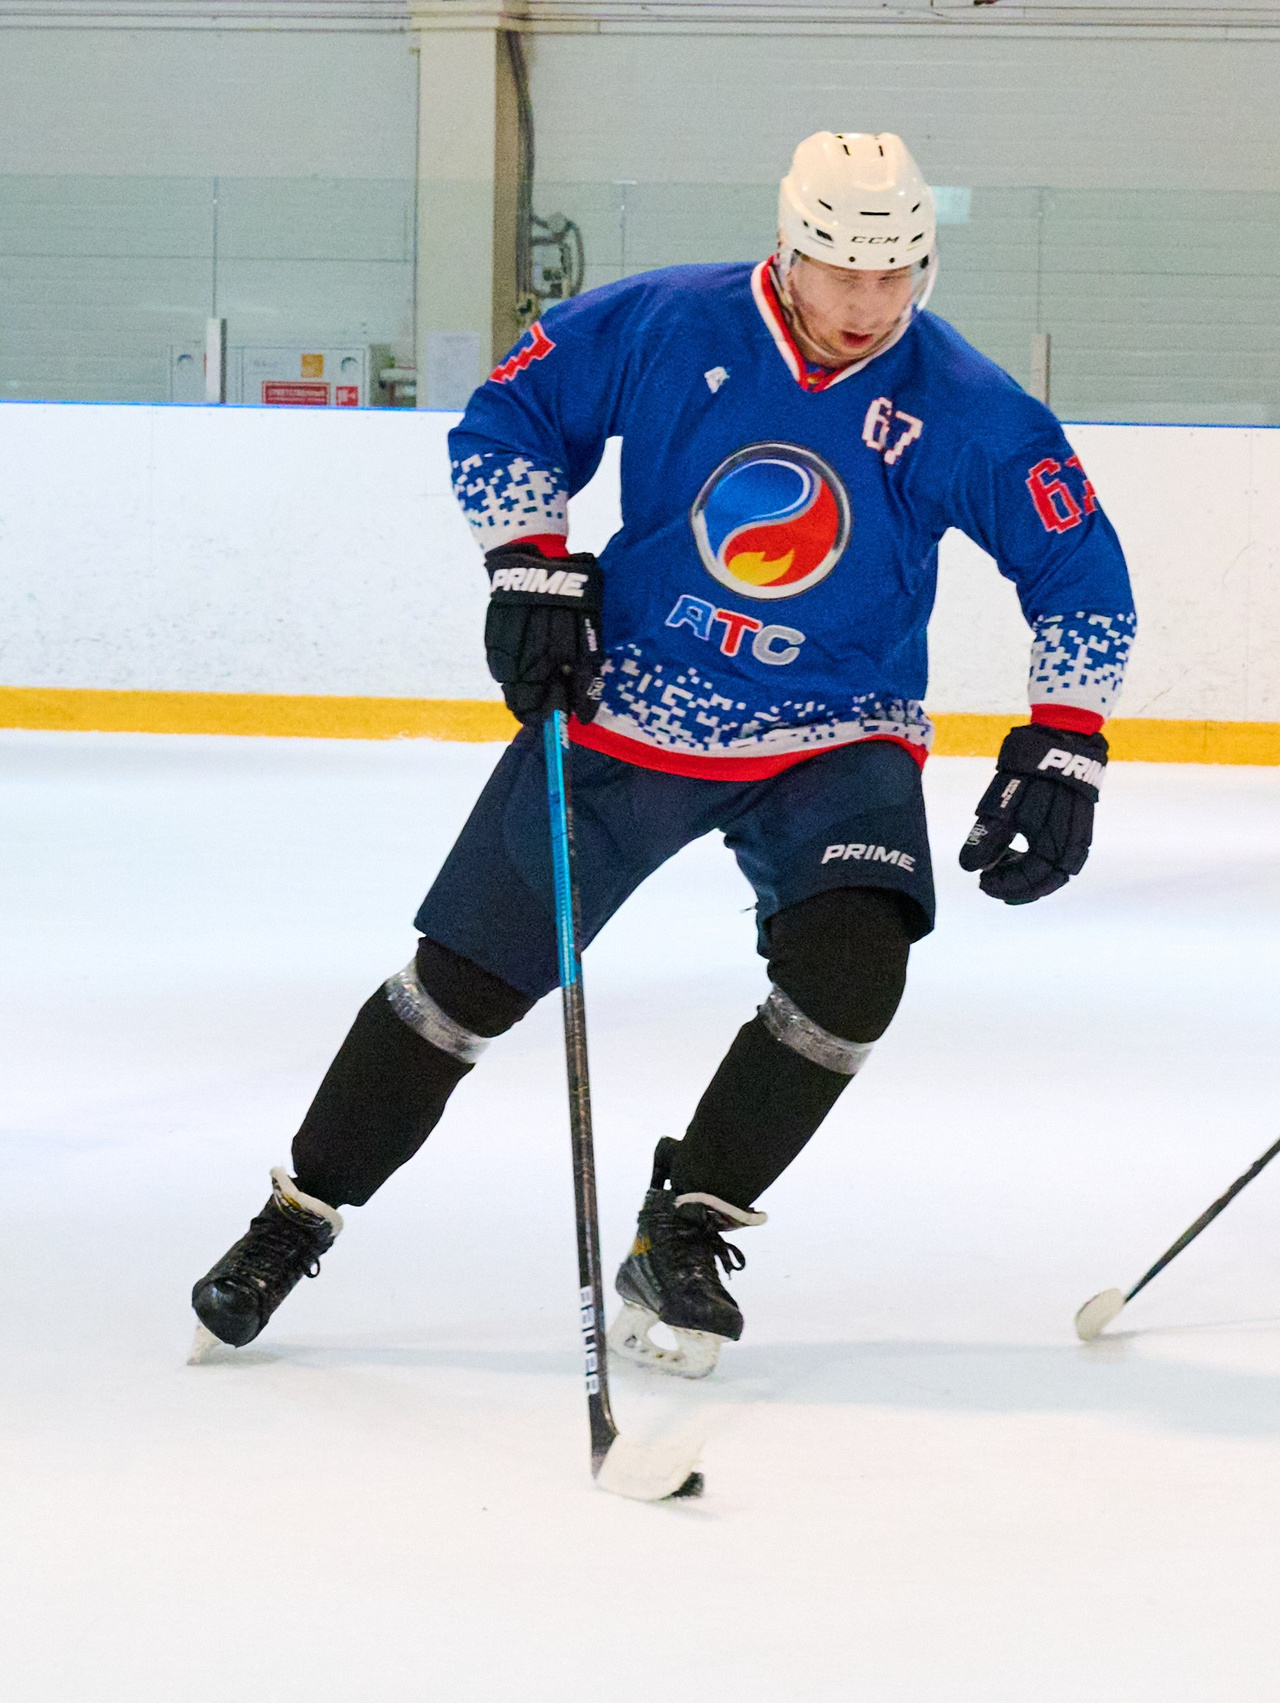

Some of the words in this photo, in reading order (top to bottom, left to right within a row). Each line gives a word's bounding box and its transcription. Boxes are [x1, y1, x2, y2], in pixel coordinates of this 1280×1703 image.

[851, 236, 900, 245] CCM
[861, 397, 924, 466] 67
[491, 567, 589, 597] PRIME
[664, 593, 806, 667] ATC
[820, 843, 916, 873] PRIME
